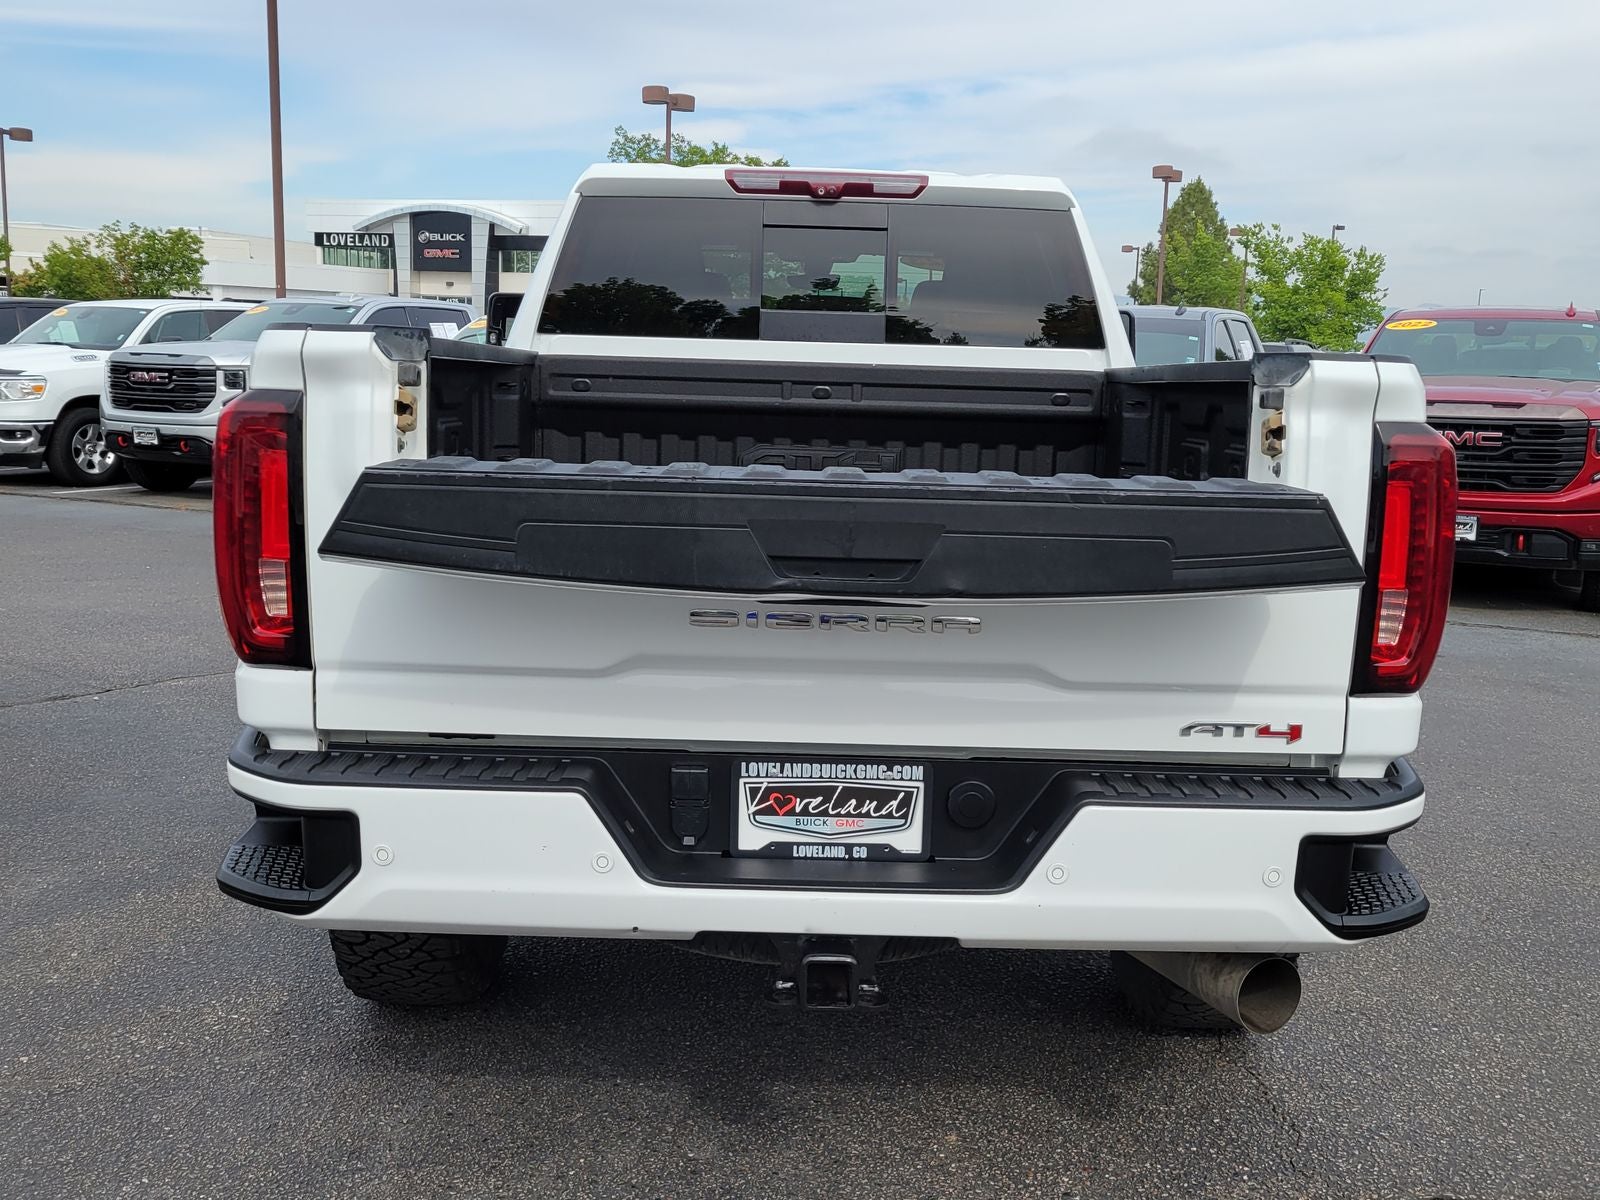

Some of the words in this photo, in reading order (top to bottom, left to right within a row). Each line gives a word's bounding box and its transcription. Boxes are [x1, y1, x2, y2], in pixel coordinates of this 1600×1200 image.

[323, 233, 390, 247] LOVELAND
[429, 233, 466, 242] BUICK
[423, 249, 460, 258] GMC
[127, 371, 169, 382] GMC
[1437, 430, 1503, 446] MC
[689, 609, 982, 635] SIERRA
[1179, 720, 1303, 745] AT4
[740, 761, 924, 780] LOVELANDBUICKGMCCOM
[795, 818, 829, 827] BUICK
[835, 818, 865, 828] GMC
[792, 845, 849, 859] LOVELAND,
[852, 846, 868, 859] CO
